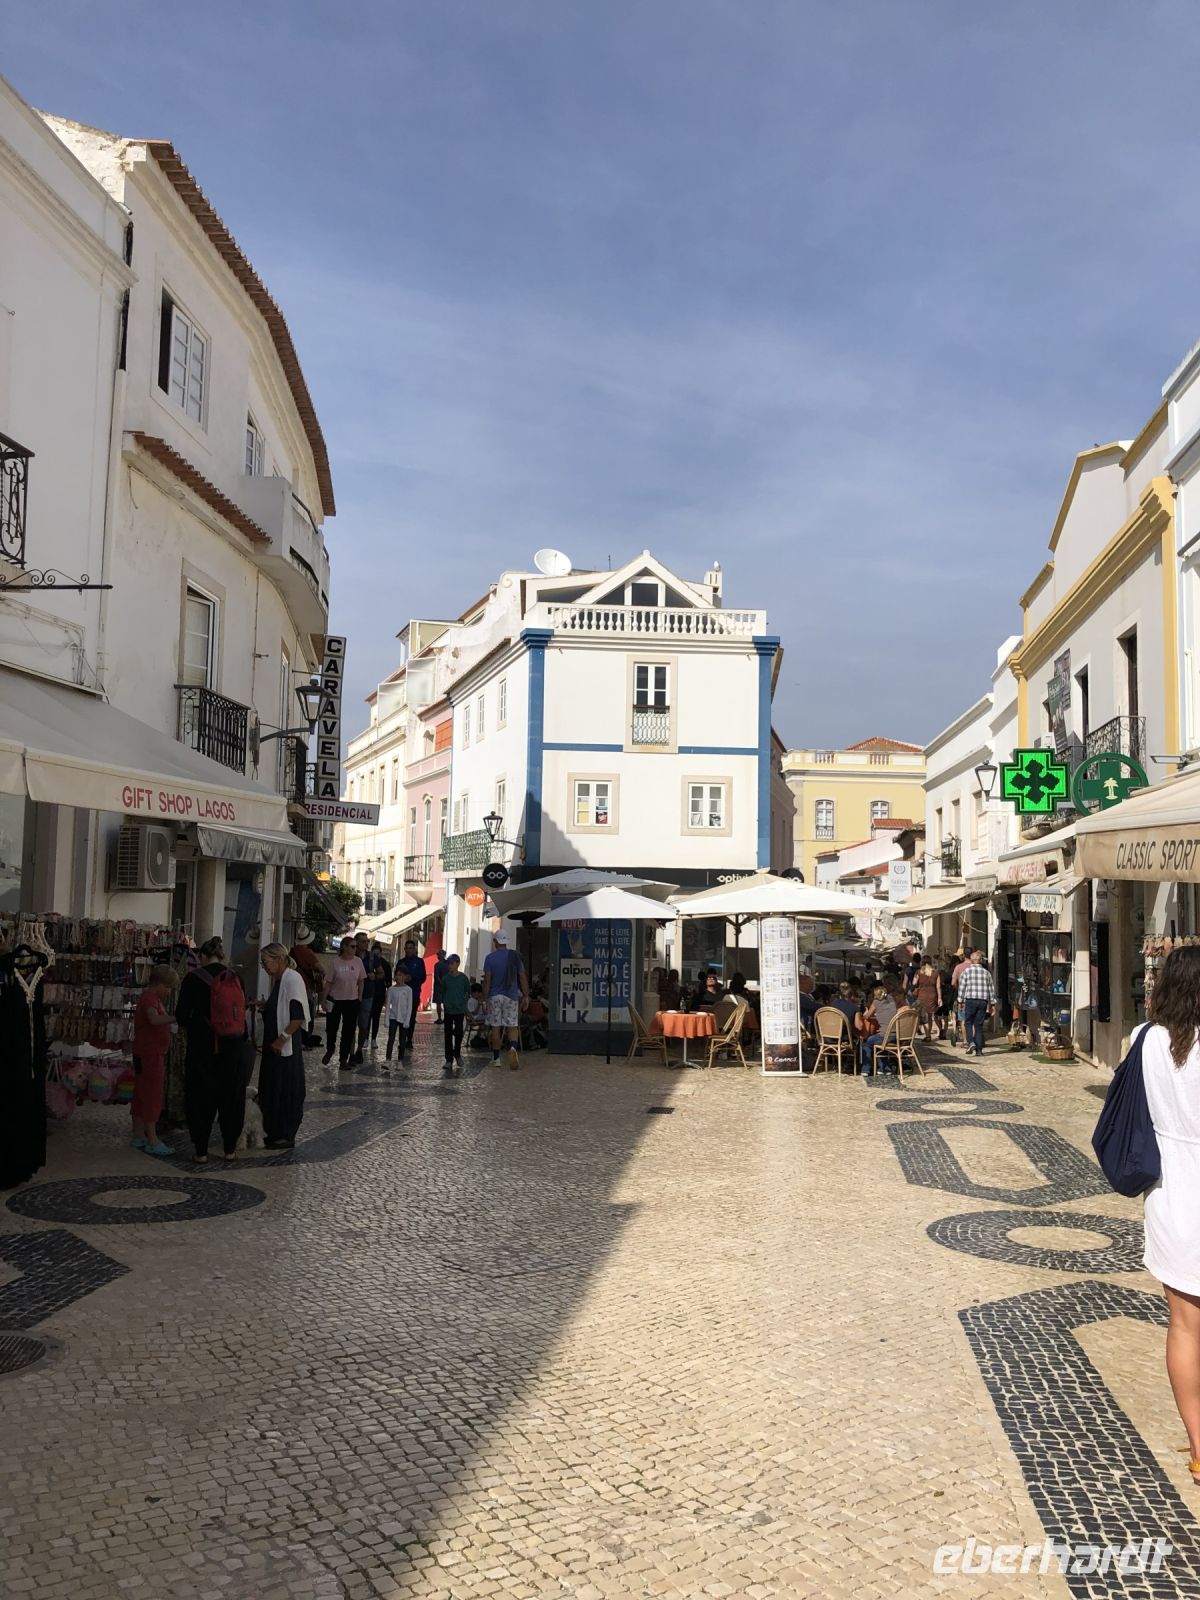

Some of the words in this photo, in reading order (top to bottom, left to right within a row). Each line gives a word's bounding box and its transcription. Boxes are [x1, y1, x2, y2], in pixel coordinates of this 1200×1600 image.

[321, 637, 342, 798] CARAVELA
[122, 786, 153, 810] GIFT
[158, 791, 193, 815] SHOP
[196, 798, 236, 821] LAGOS
[305, 803, 373, 820] RESIDENCIAL
[1116, 840, 1156, 870] CLASSIC
[1159, 839, 1200, 871] SPORT
[467, 893, 484, 901] ATM
[594, 928, 615, 936] PAREE
[615, 937, 630, 945] LEITE
[562, 964, 592, 978] alpro
[572, 982, 591, 992] NOT
